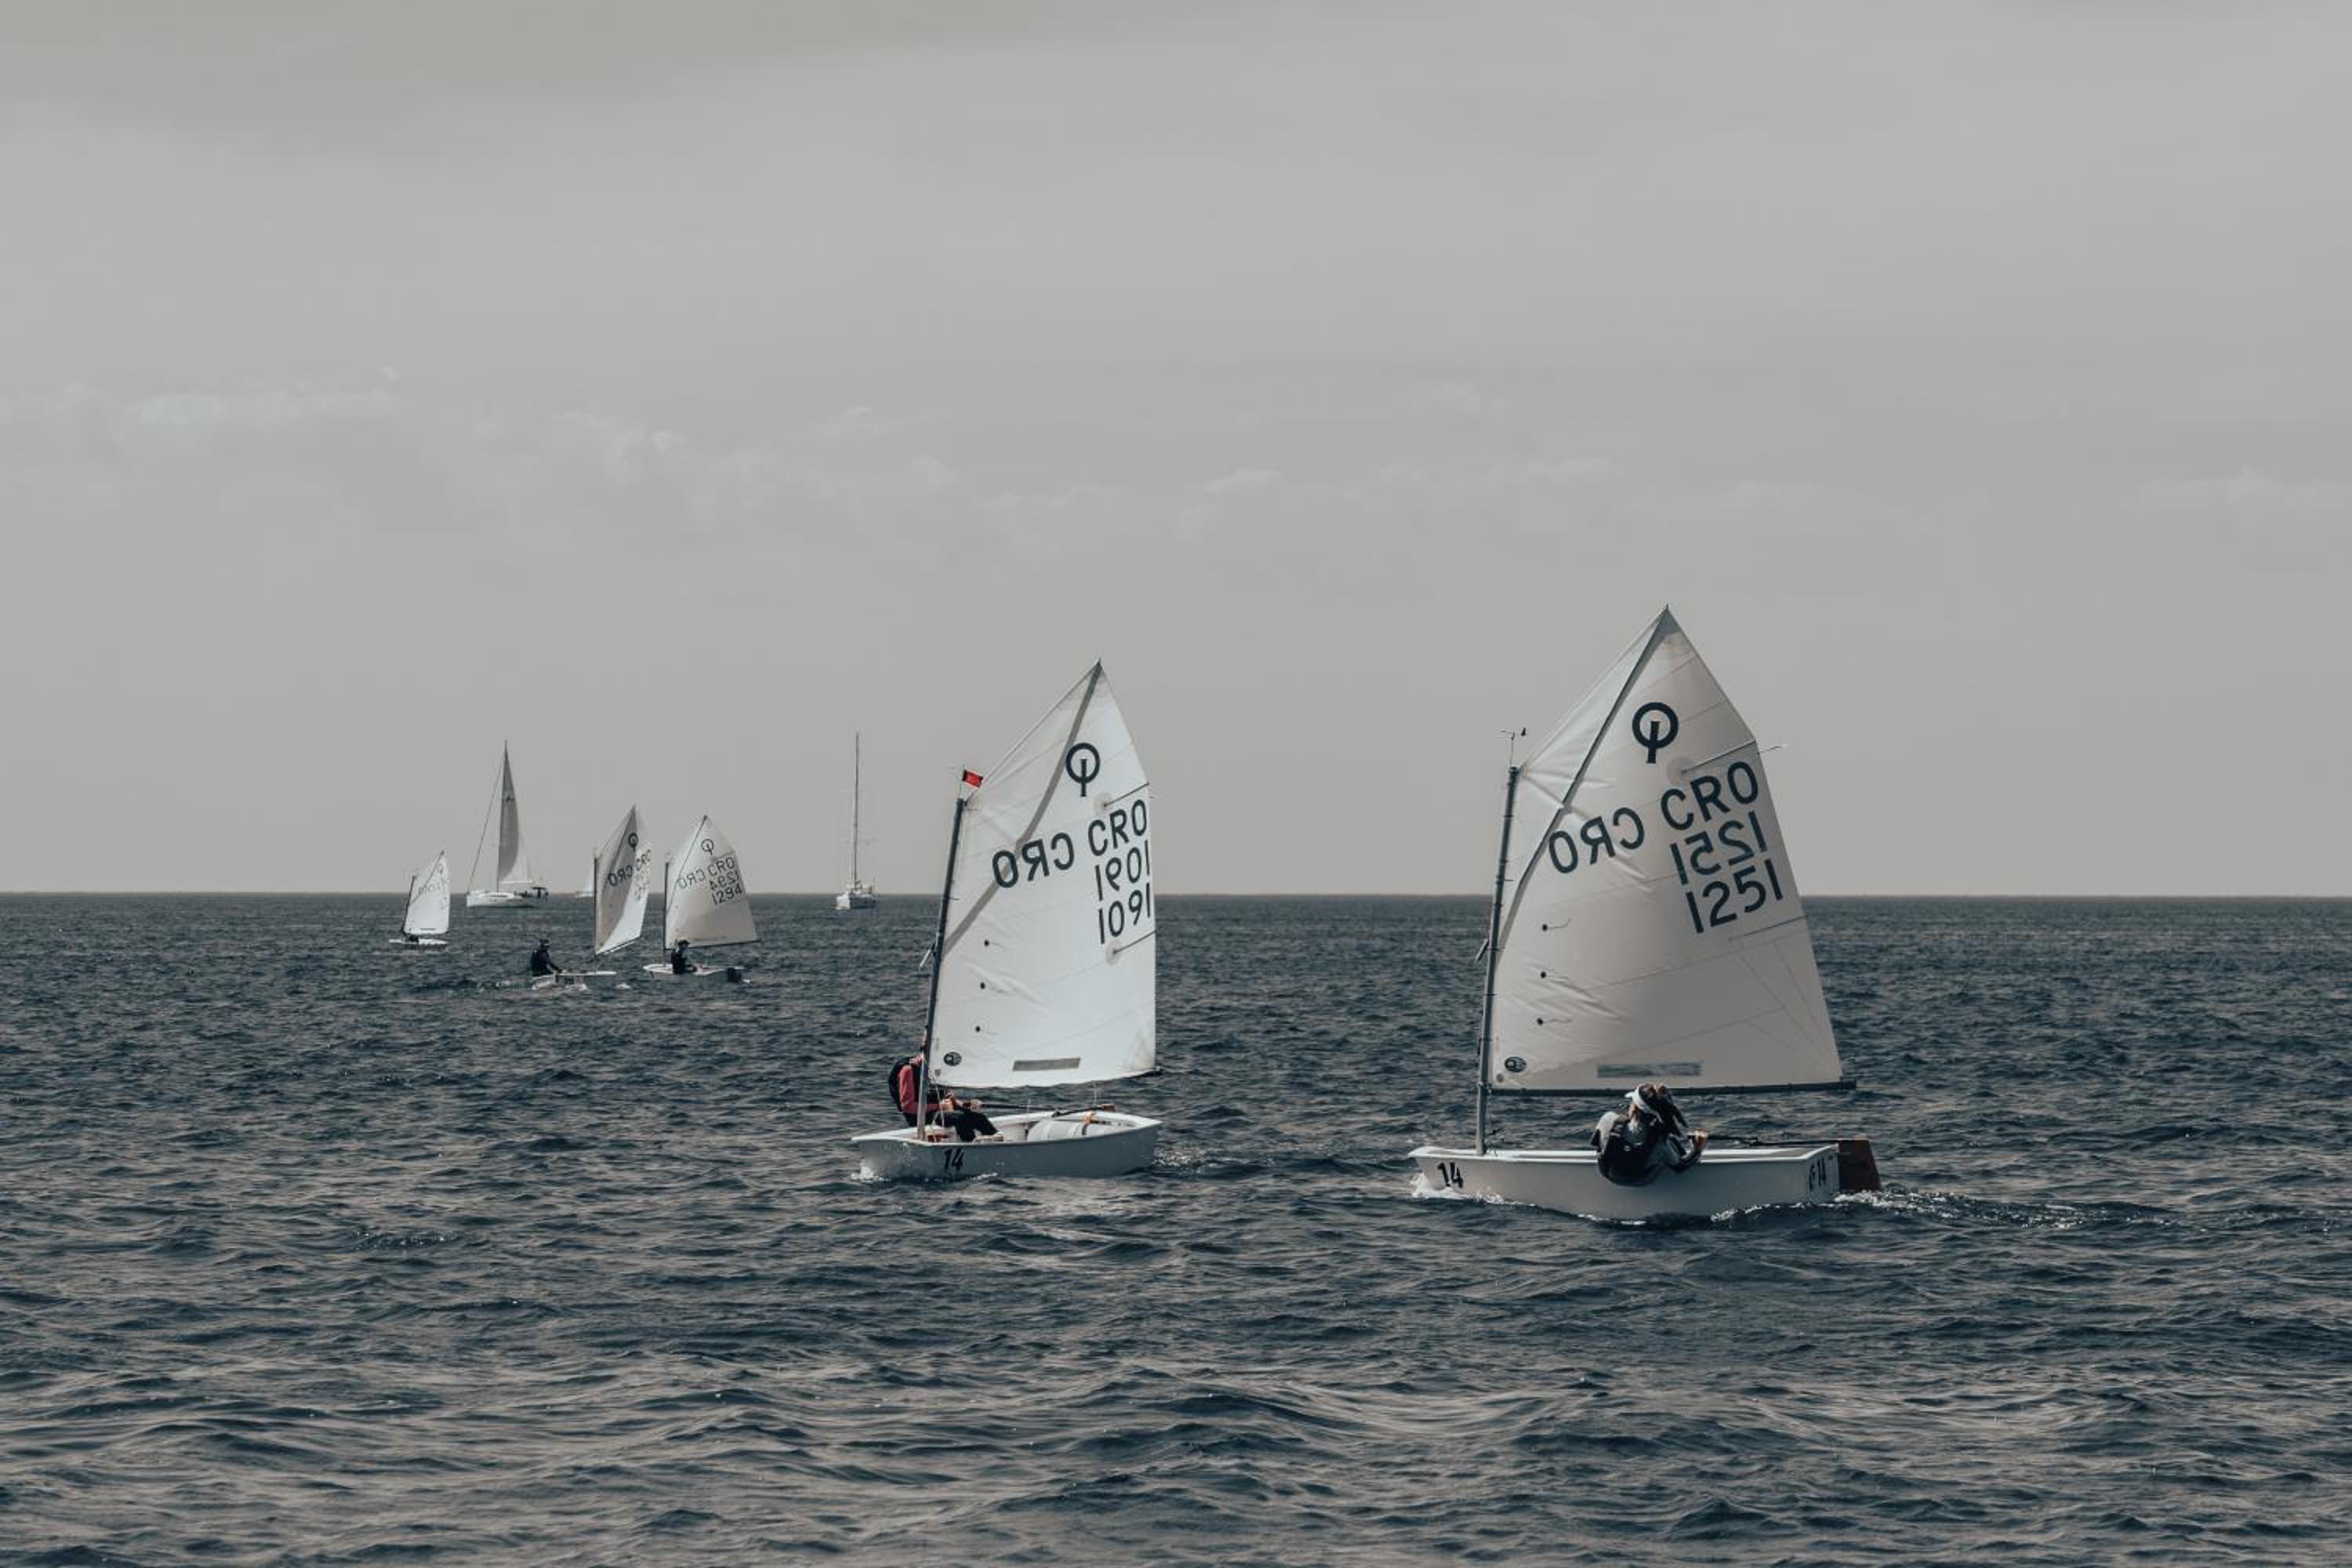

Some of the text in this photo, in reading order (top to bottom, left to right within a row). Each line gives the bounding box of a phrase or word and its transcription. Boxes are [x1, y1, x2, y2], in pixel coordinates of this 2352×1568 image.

[1660, 761, 1759, 830] CRO
[1087, 799, 1147, 856] CRO
[708, 857, 735, 877] CRO
[711, 883, 742, 905] 1294
[1098, 883, 1150, 944] 1091
[1686, 858, 1784, 934] 1251
[943, 1146, 964, 1171] 14
[1437, 1161, 1464, 1189] 14
